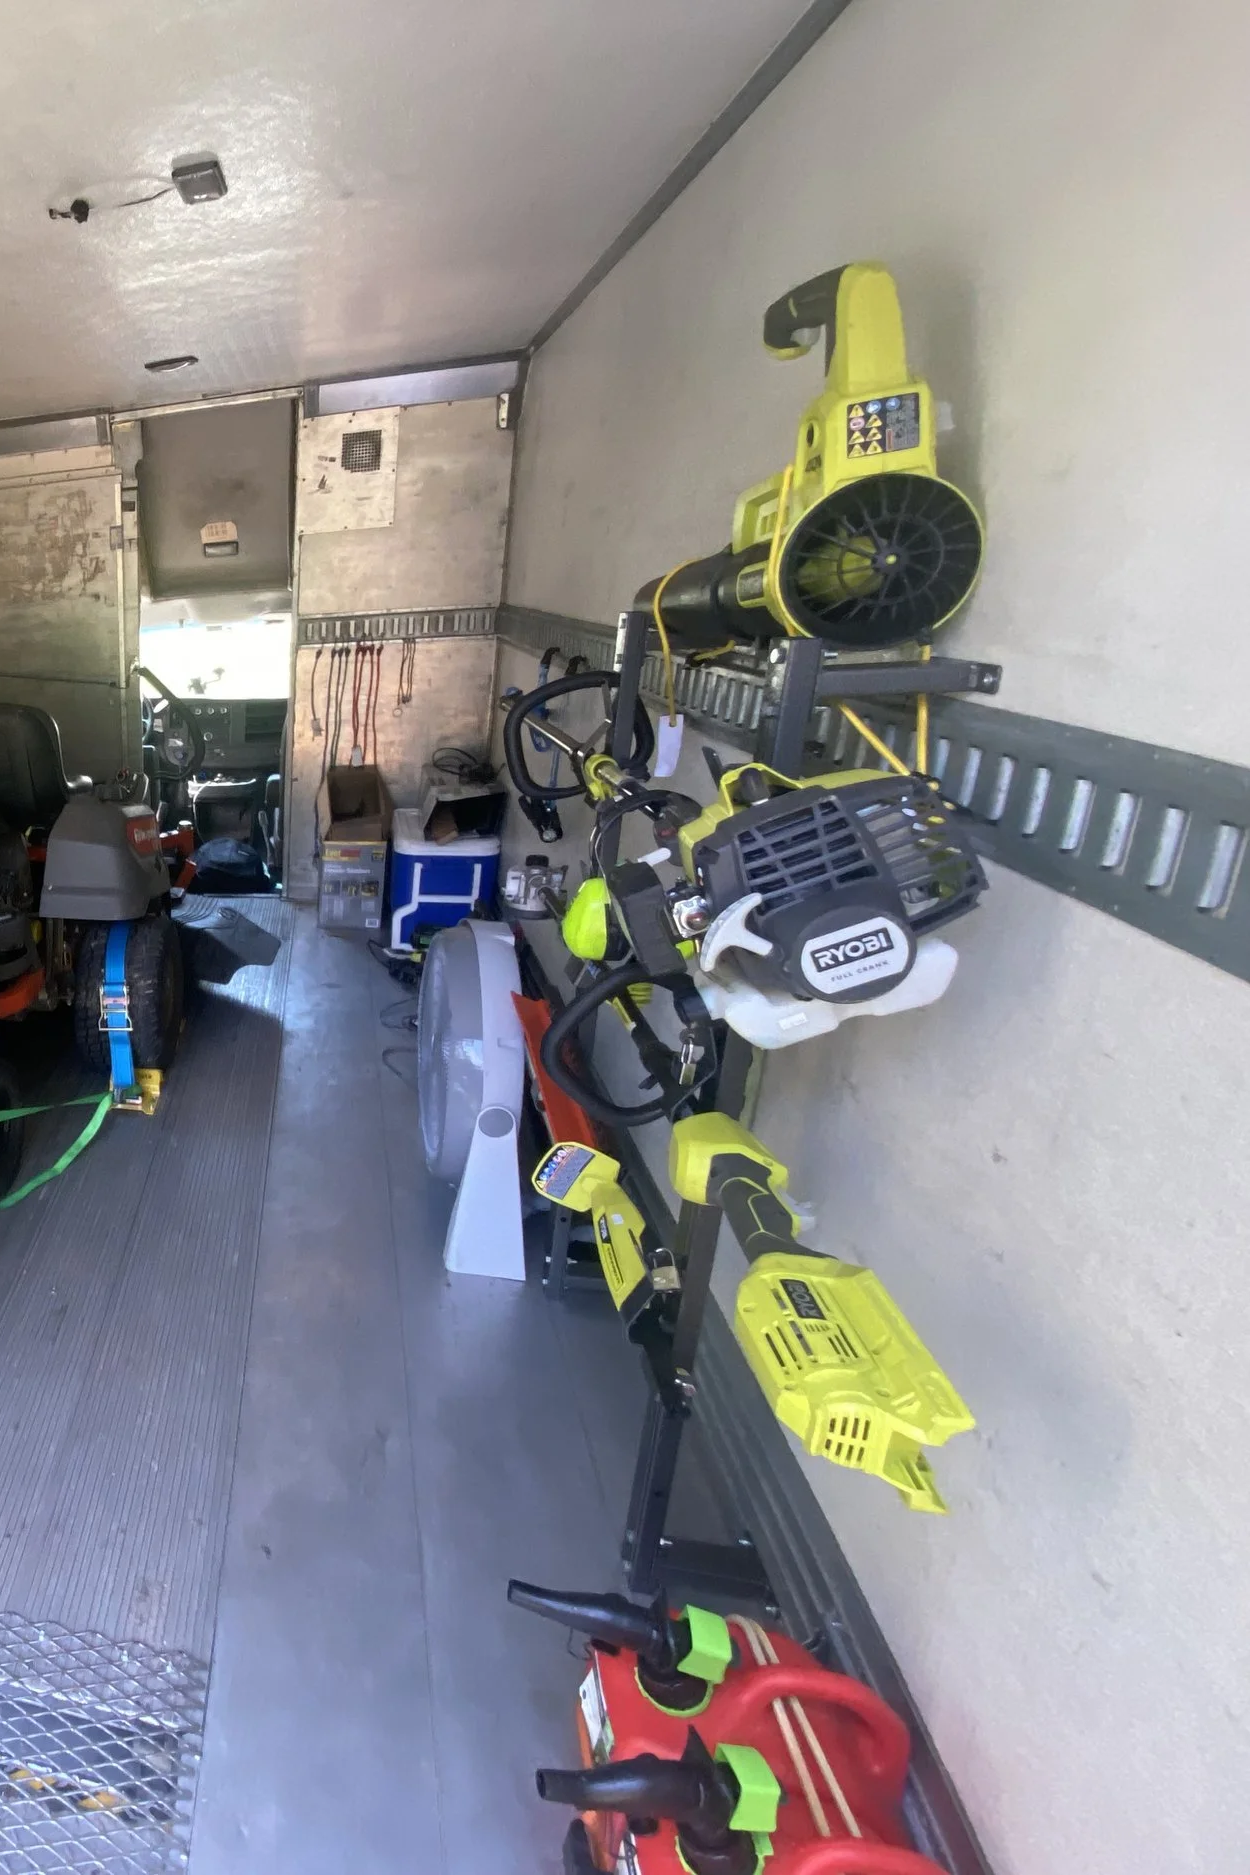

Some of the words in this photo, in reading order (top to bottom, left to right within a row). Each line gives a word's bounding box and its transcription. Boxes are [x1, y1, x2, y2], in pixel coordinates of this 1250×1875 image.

[814, 932, 888, 968] RYOBI
[830, 973, 854, 982] FULL
[856, 960, 889, 974] CRANK
[786, 1281, 821, 1318] RYOBI
